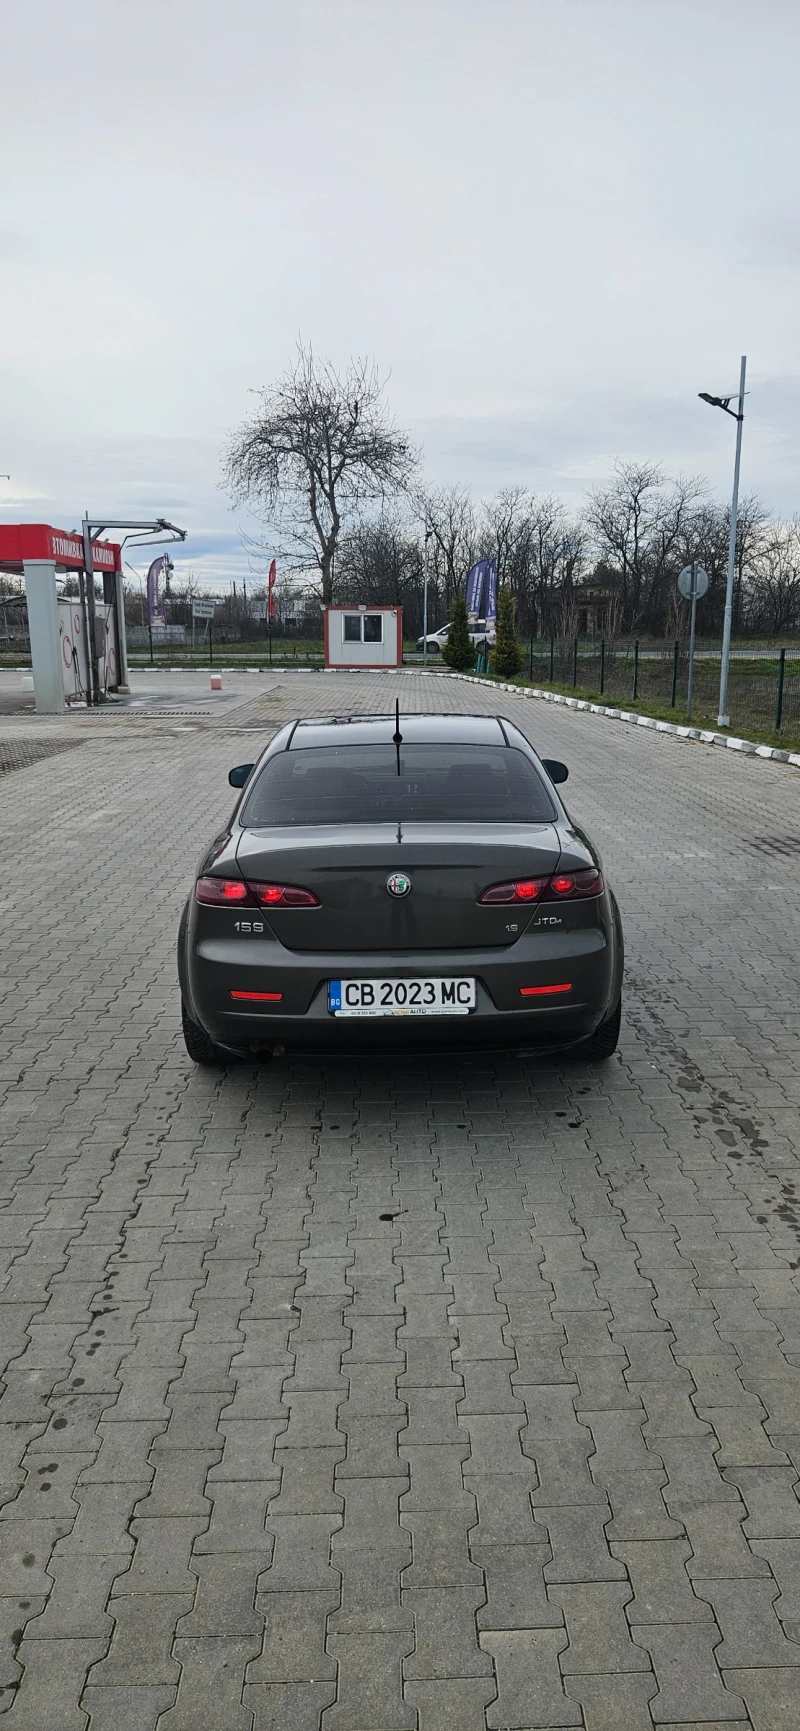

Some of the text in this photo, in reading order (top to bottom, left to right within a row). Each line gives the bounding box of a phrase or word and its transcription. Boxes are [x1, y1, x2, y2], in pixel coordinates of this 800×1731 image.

[234, 921, 264, 933] 159
[345, 981, 471, 1006] CB 2023 MC
[330, 998, 341, 1006] BG
